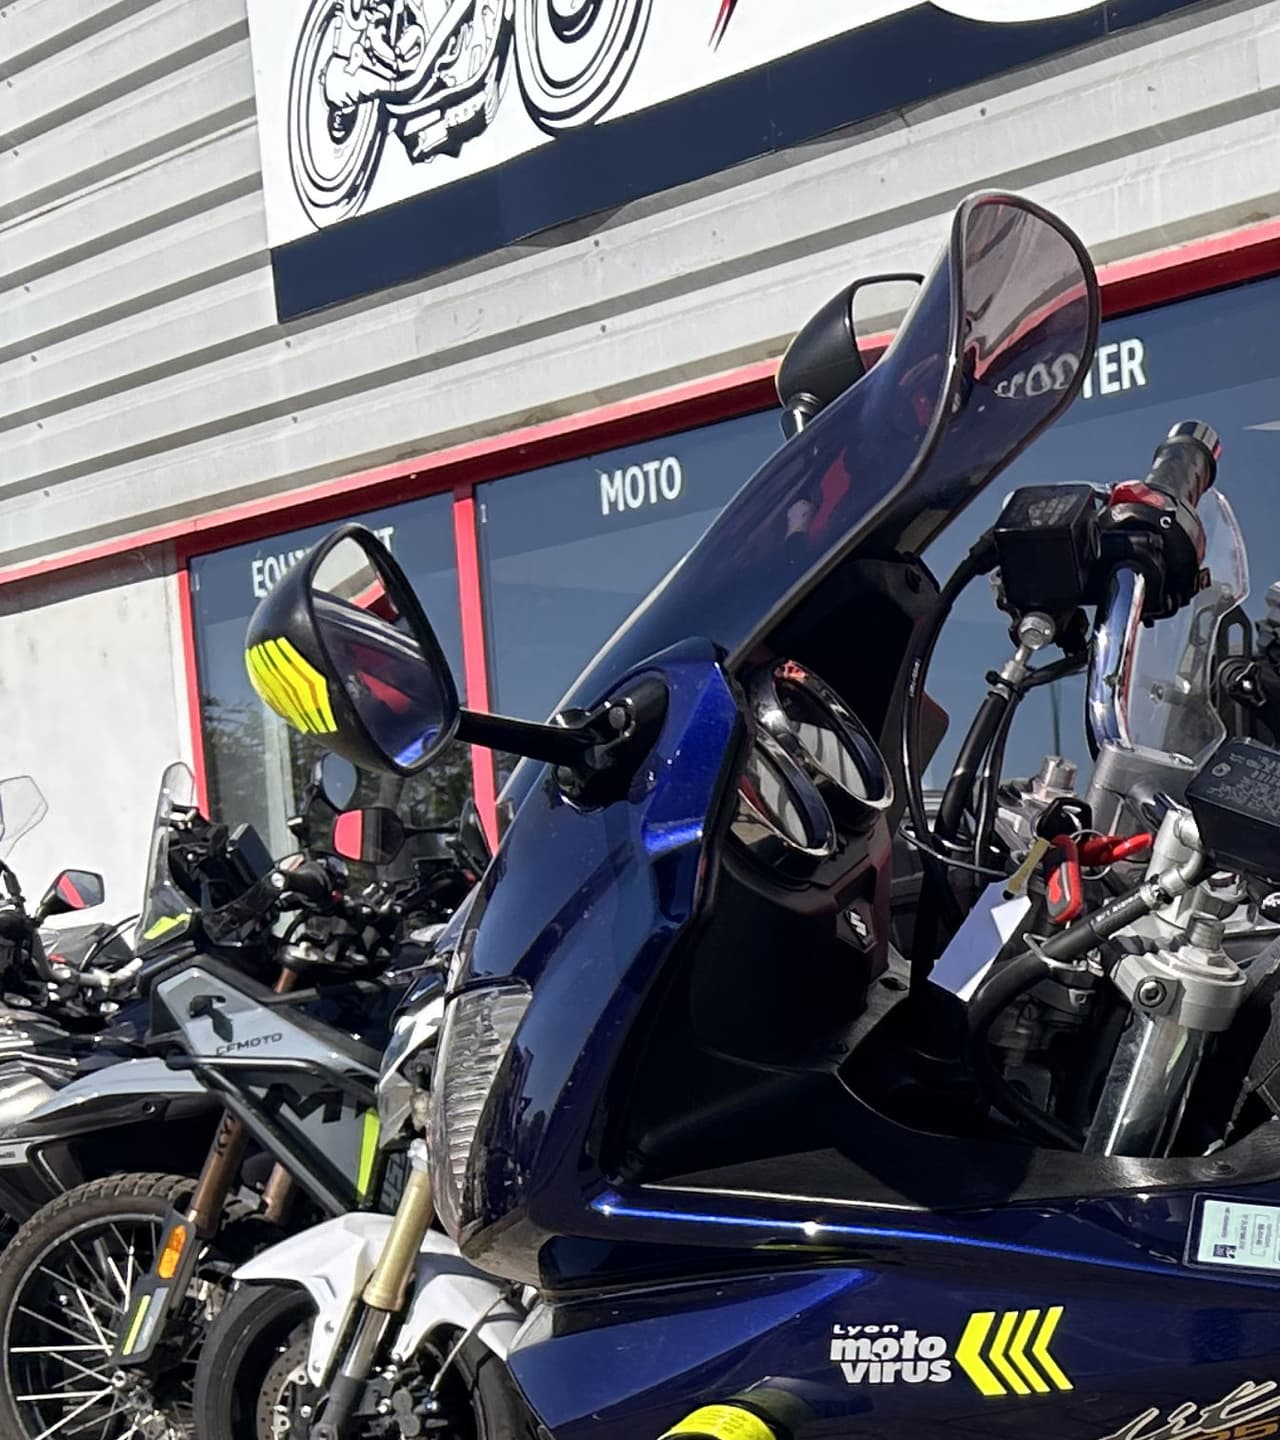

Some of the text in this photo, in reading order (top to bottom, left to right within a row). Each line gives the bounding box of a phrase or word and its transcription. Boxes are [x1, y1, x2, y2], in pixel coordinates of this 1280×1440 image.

[600, 456, 682, 516] MOTO
[216, 1032, 283, 1056] CFMOTO
[832, 1323, 899, 1336] Lyon
[829, 1330, 948, 1361] moto
[840, 1359, 953, 1384] virus
